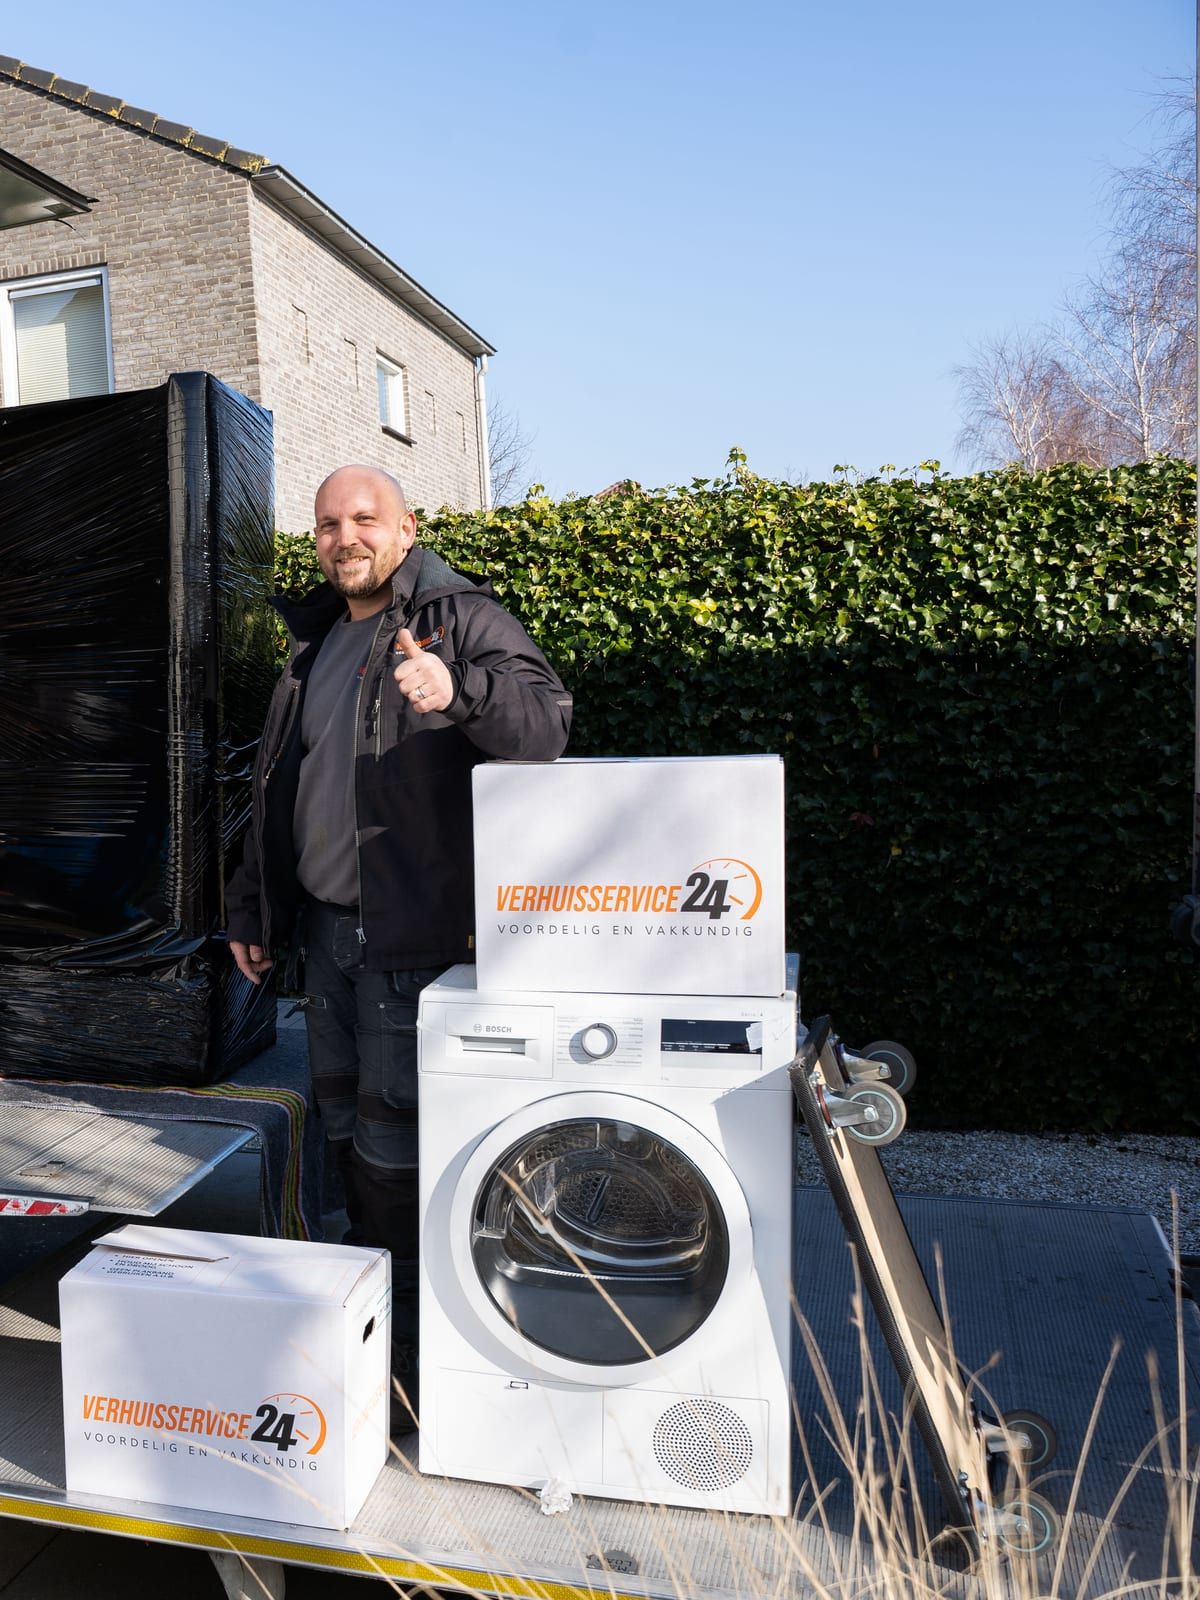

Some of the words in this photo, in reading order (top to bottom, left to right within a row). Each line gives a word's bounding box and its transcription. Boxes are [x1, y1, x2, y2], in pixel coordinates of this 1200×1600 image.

[495, 884, 681, 913] VERHUISSERVICE
[680, 872, 731, 920] 24
[497, 923, 601, 936] VOORDELIG
[612, 924, 634, 936] EN
[645, 924, 753, 937] VAKKUNDIG
[485, 1025, 512, 1033] BOSCH
[82, 1394, 252, 1440] VERHUISSERVICE
[250, 1404, 298, 1451] 24
[83, 1431, 178, 1454] VOORDELIG
[188, 1445, 209, 1458] EN
[218, 1449, 318, 1471] VAKKUNDIG
